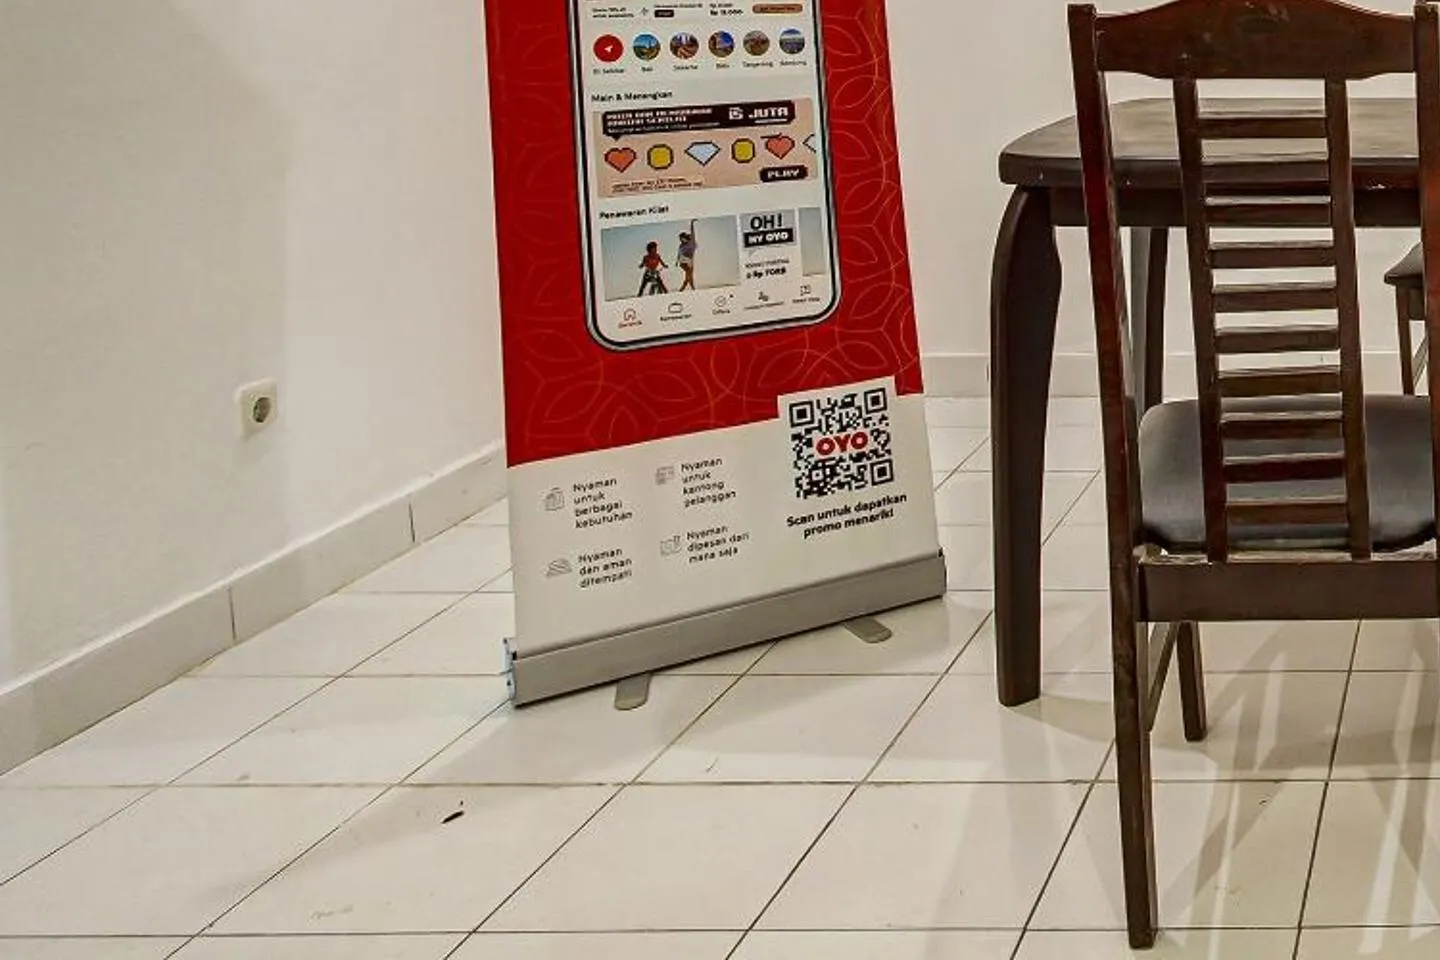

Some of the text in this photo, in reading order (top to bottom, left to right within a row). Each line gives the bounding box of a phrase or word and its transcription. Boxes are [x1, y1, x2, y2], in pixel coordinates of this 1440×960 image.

[748, 106, 789, 119] JUTA
[750, 213, 783, 230] OH!
[765, 231, 789, 242] OYO
[816, 431, 869, 456] OYO
[681, 458, 723, 472] Nyaman
[573, 477, 617, 491] Nyaman
[682, 471, 711, 483] untuk
[574, 491, 606, 504] untuk
[685, 490, 737, 508] pelanggan
[575, 499, 623, 517] berbagai
[787, 493, 907, 527] Scan untuk dapatkan
[575, 512, 633, 529] kebutuhan
[804, 508, 895, 540] promo menarik!
[686, 525, 729, 541] Nyaman
[687, 538, 727, 553] dipesan
[578, 547, 623, 563] Nyaman
[579, 563, 600, 576] dan
